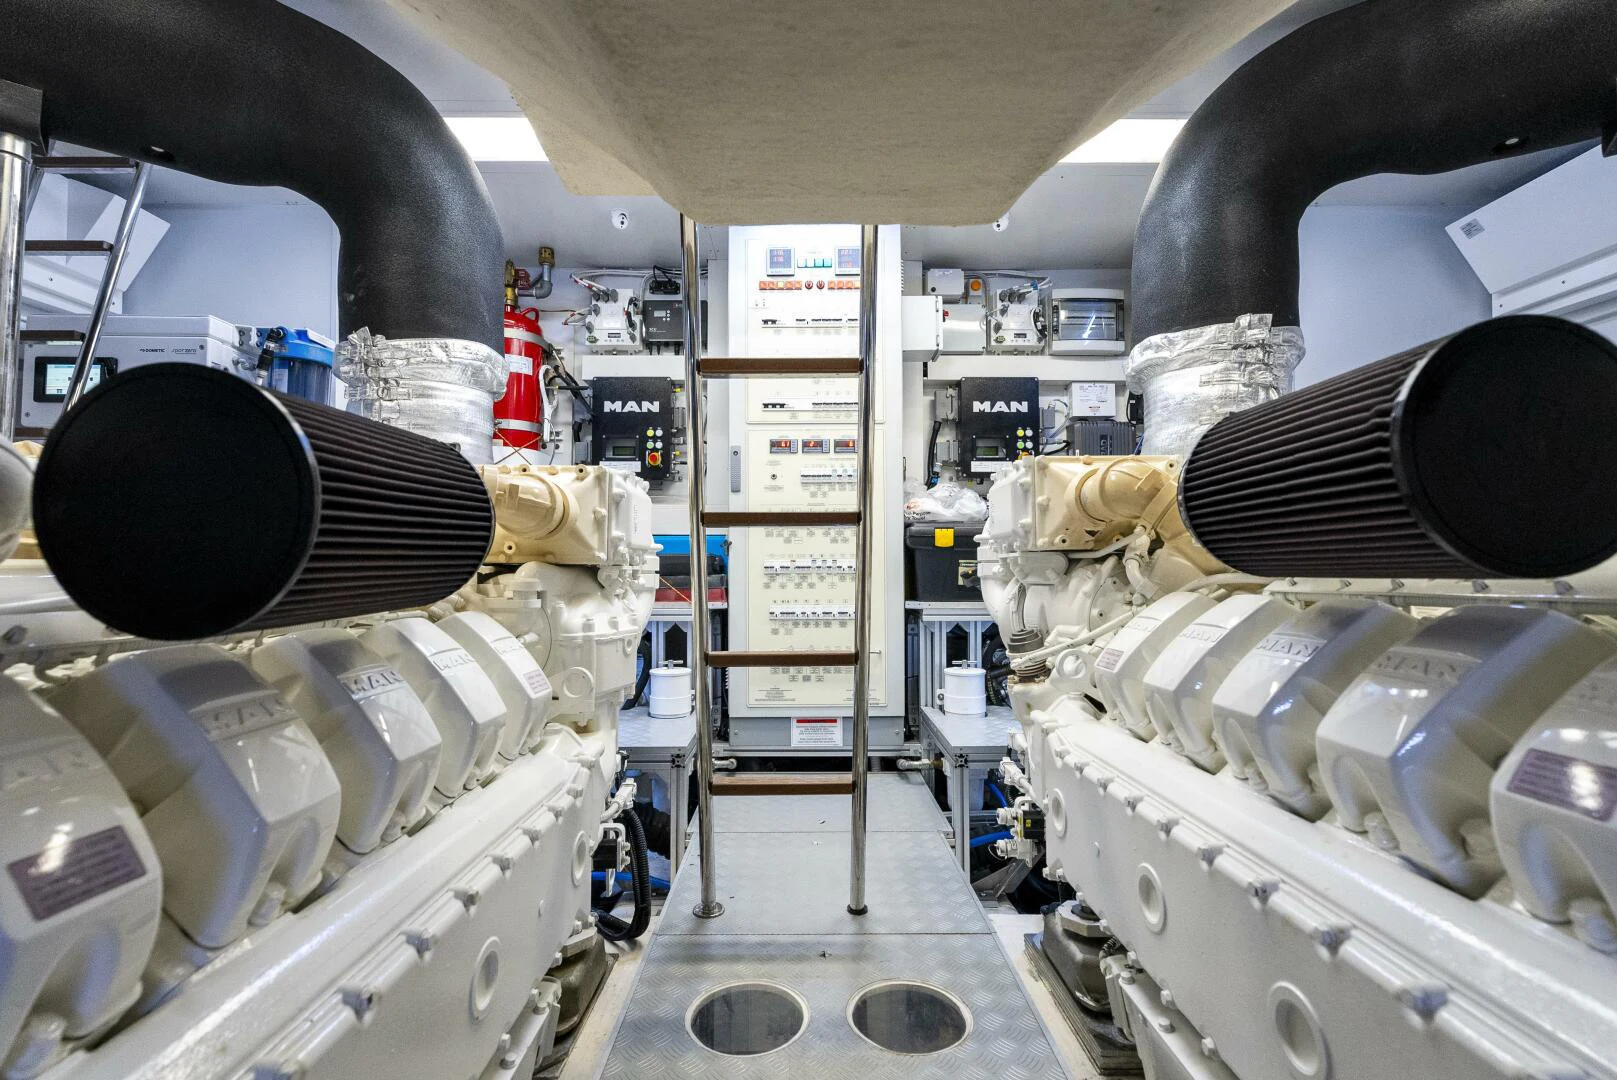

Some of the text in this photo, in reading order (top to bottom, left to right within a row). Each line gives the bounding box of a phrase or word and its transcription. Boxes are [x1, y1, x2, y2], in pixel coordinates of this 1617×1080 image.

[603, 401, 660, 413] MAN
[973, 401, 1029, 413] MAN
[1178, 628, 1226, 643] MAN
[1256, 638, 1320, 658] MAN
[432, 652, 477, 671] MAN
[344, 670, 404, 695] MAN
